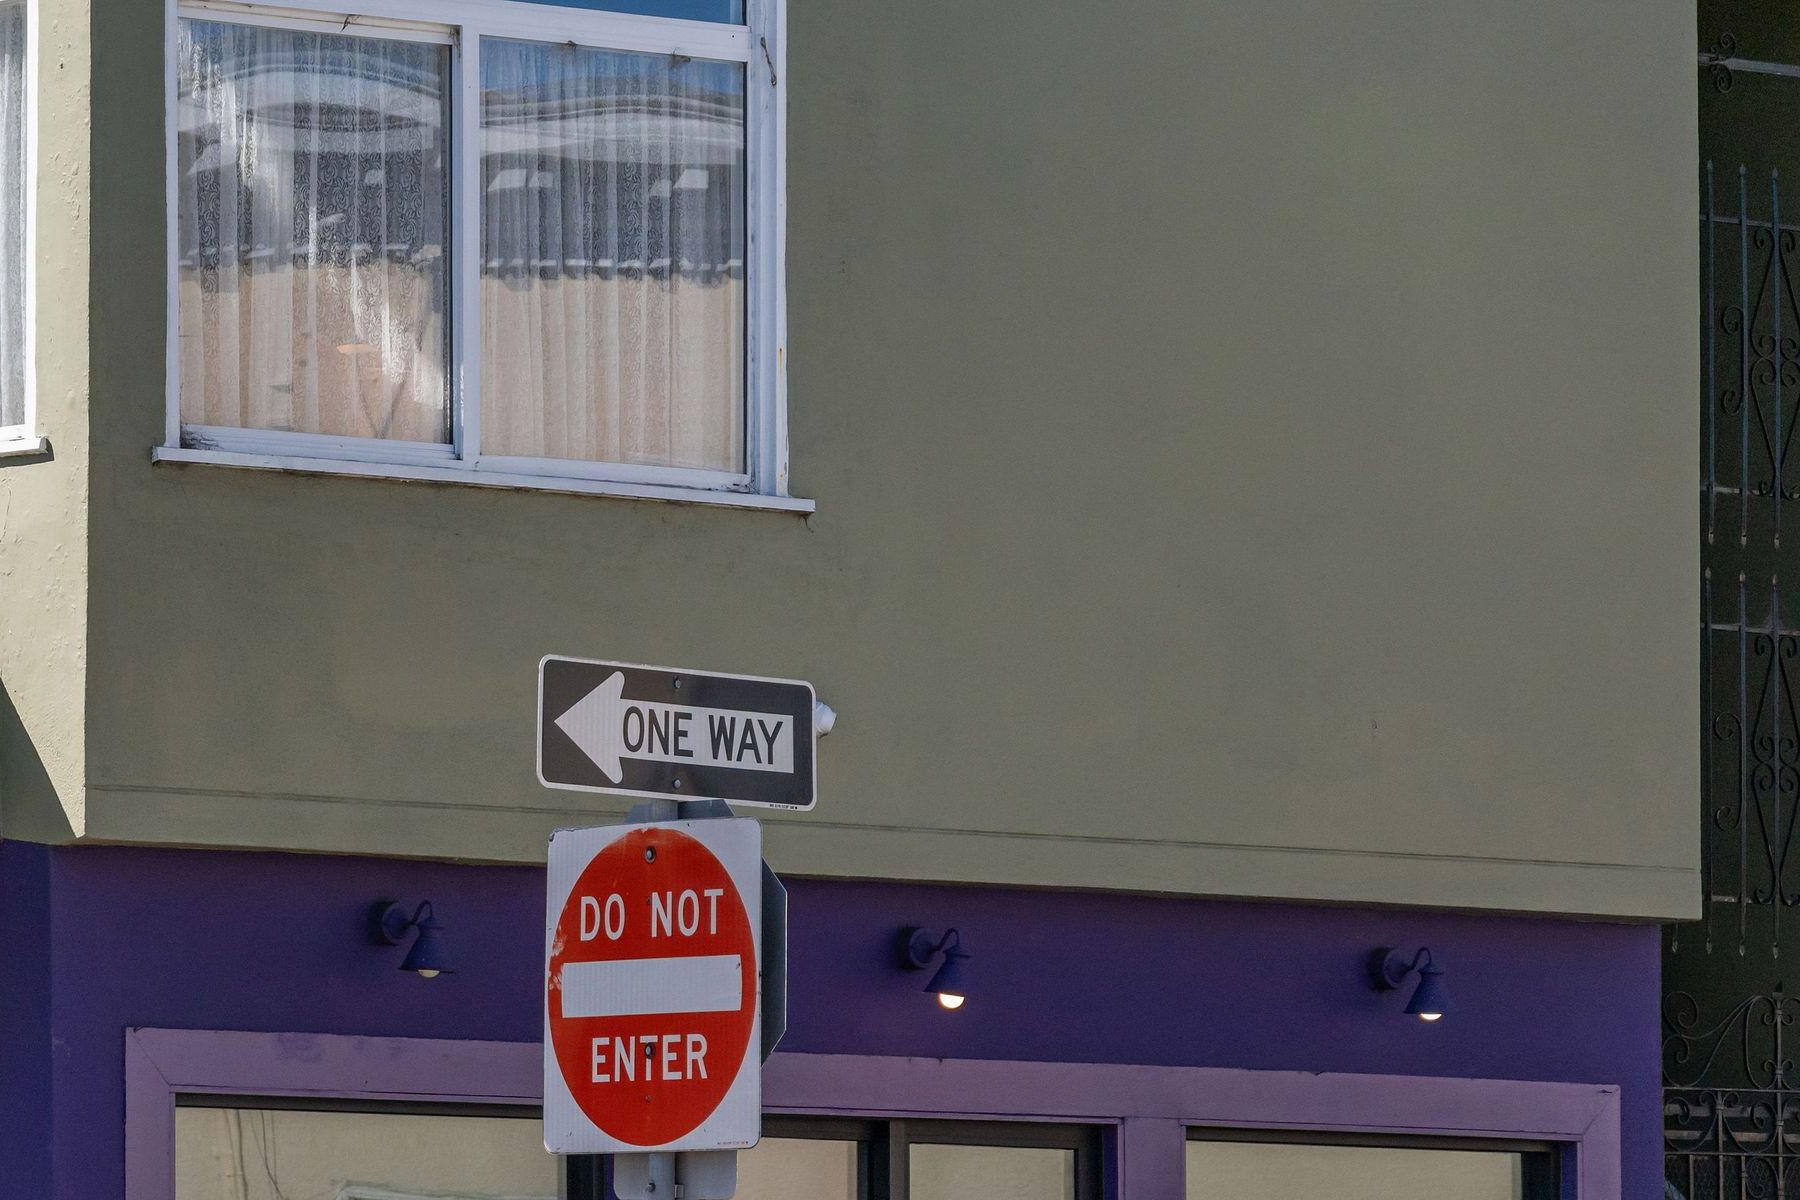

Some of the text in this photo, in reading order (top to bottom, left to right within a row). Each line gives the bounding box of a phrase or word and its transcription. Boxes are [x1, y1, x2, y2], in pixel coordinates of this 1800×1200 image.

[622, 705, 784, 766] ONE WAY
[580, 887, 724, 942] DO NOT
[591, 1033, 708, 1083] ENTER
